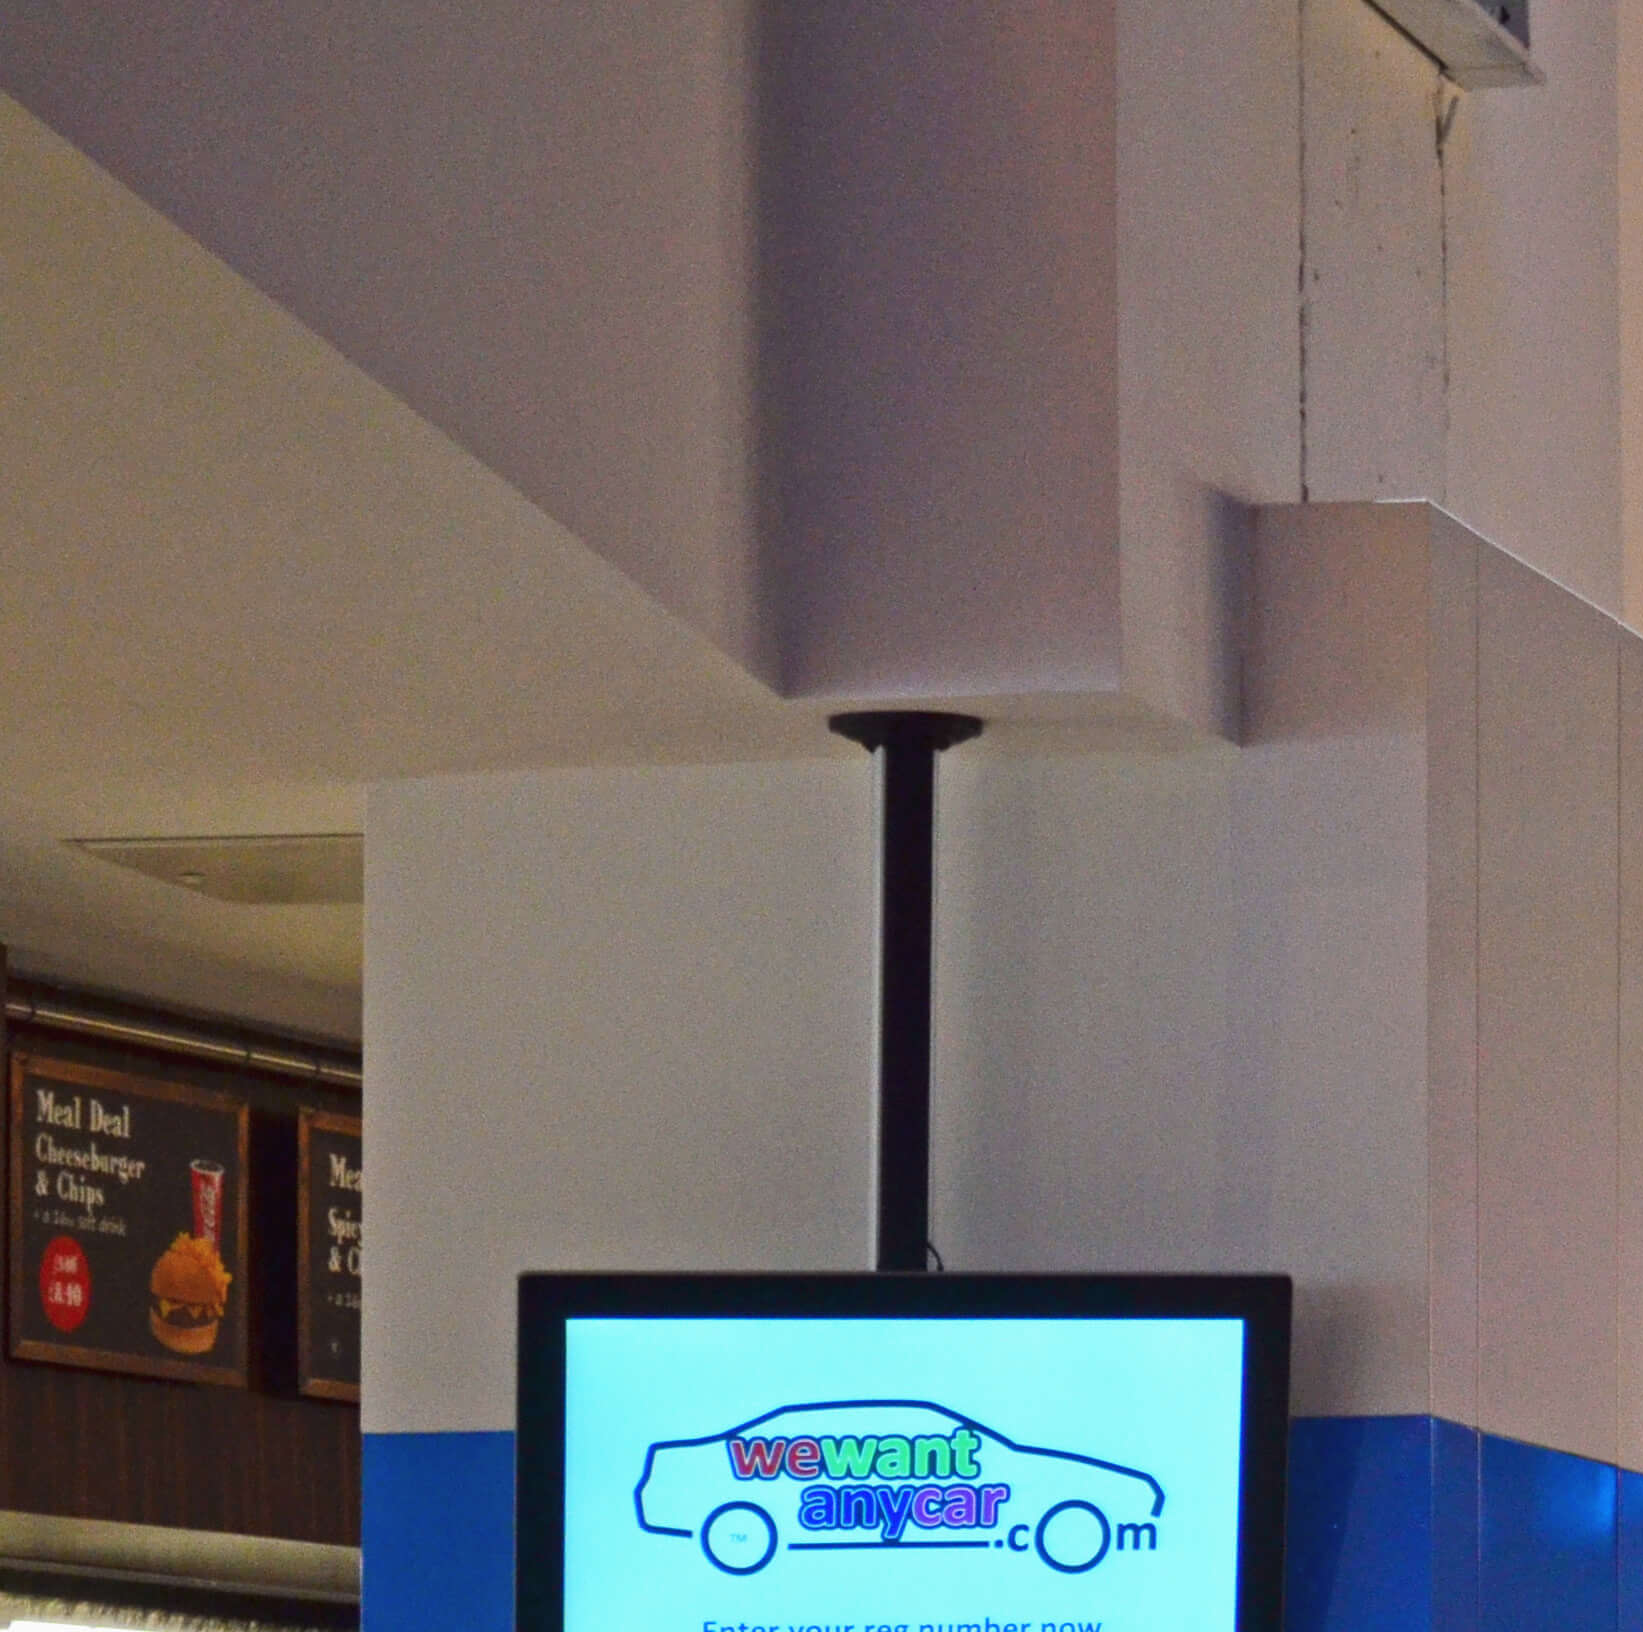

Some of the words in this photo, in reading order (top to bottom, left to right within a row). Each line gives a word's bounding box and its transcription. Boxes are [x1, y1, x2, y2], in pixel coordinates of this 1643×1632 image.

[36, 1089, 82, 1129] Meal
[90, 1098, 131, 1139] Deal
[35, 1132, 146, 1184] Cheeseburger
[35, 1170, 49, 1197] &
[57, 1170, 104, 1216] Chips
[328, 1246, 342, 1274] &
[728, 1426, 981, 1480] wewant
[799, 1483, 1011, 1541] anycar
